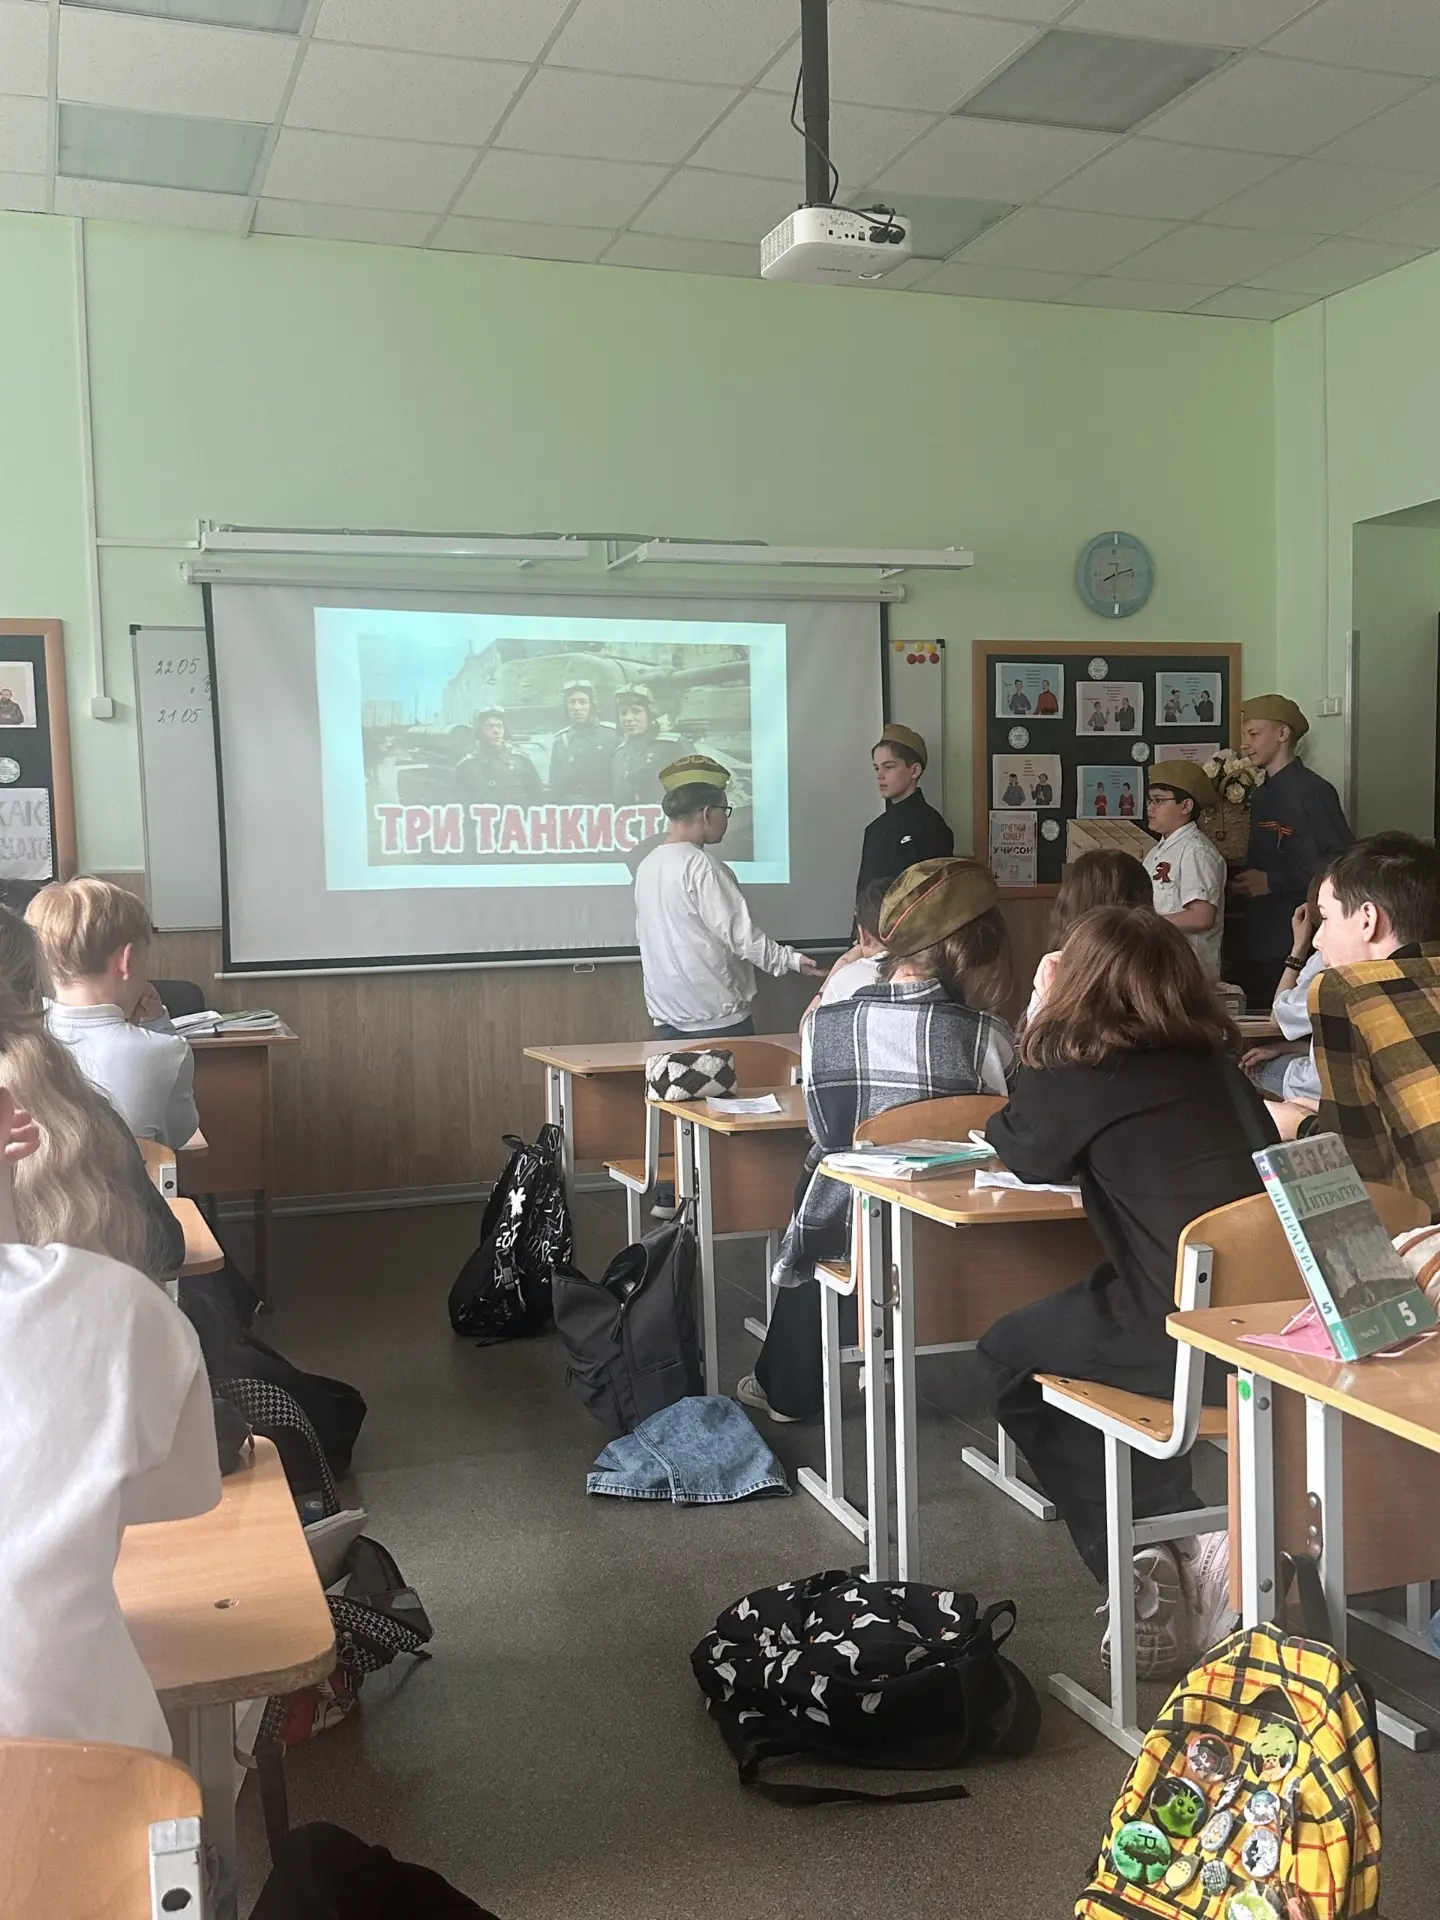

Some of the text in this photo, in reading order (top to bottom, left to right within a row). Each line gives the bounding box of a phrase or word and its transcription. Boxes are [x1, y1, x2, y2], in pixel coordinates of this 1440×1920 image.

[375, 803, 669, 854] ТРИ ТАНКИСТ
[1321, 1301, 1333, 1315] 5
[1397, 1300, 1417, 1327] 5
